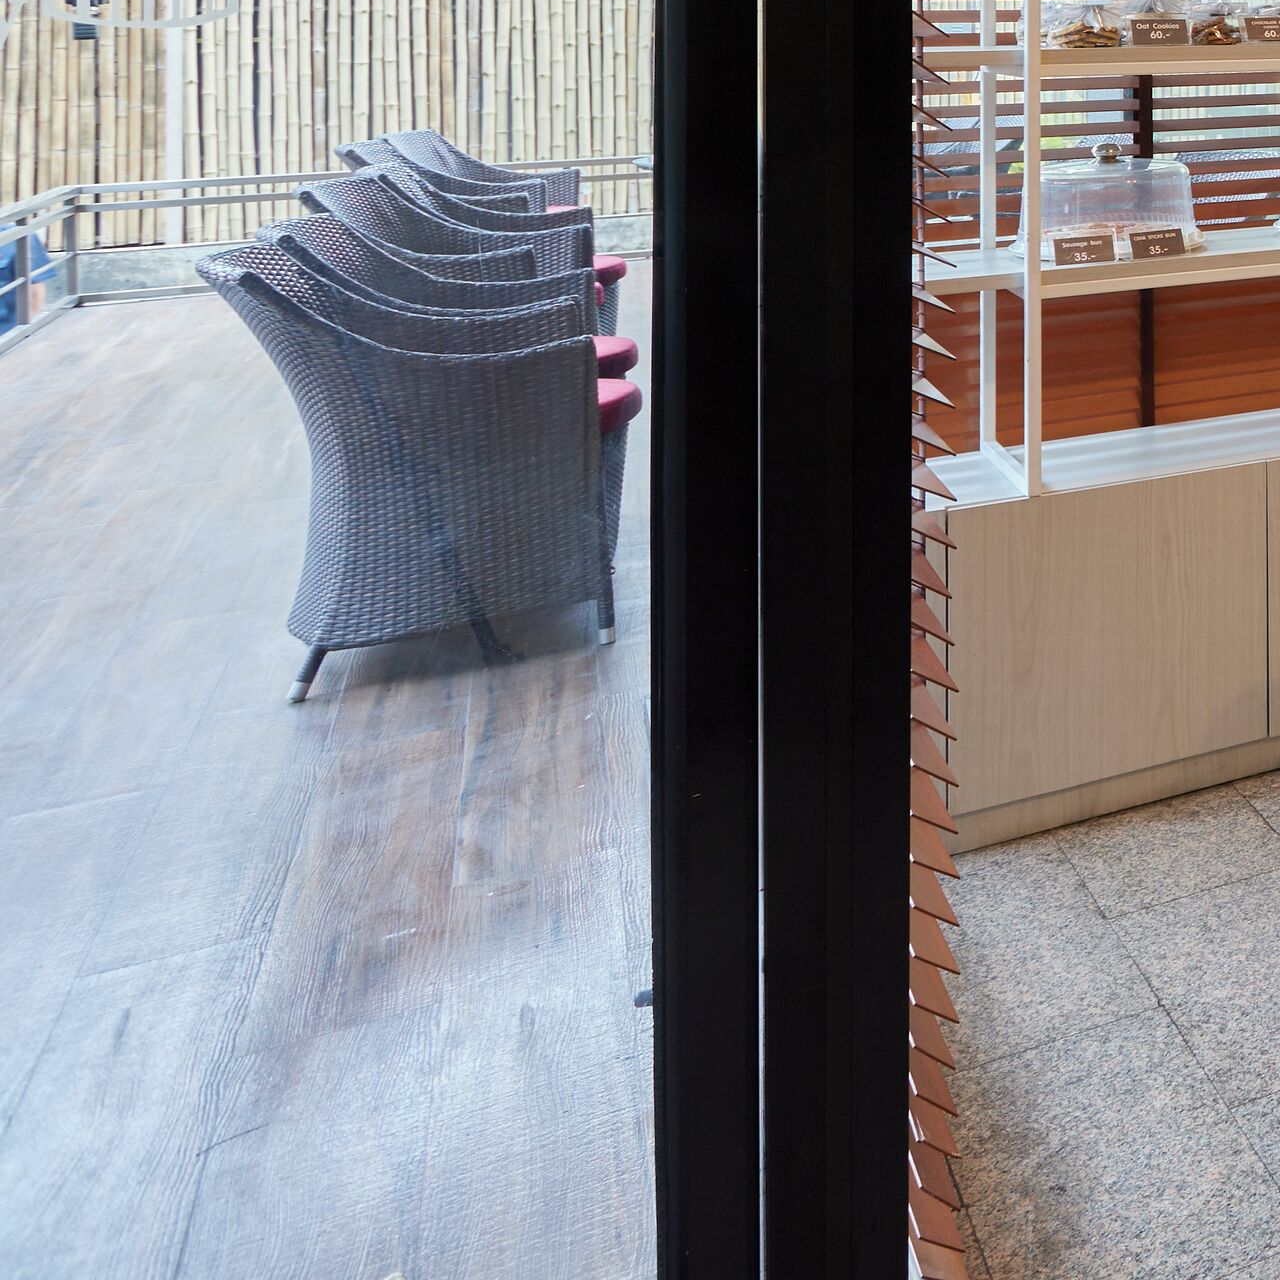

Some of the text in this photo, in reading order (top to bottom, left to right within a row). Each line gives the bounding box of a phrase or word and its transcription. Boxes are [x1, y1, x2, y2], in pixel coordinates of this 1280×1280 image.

[1150, 31, 1170, 39] 60.-
[1062, 241, 1088, 249] Sausage
[1148, 245, 1169, 255] 35.-
[1074, 252, 1096, 261] 35.-
